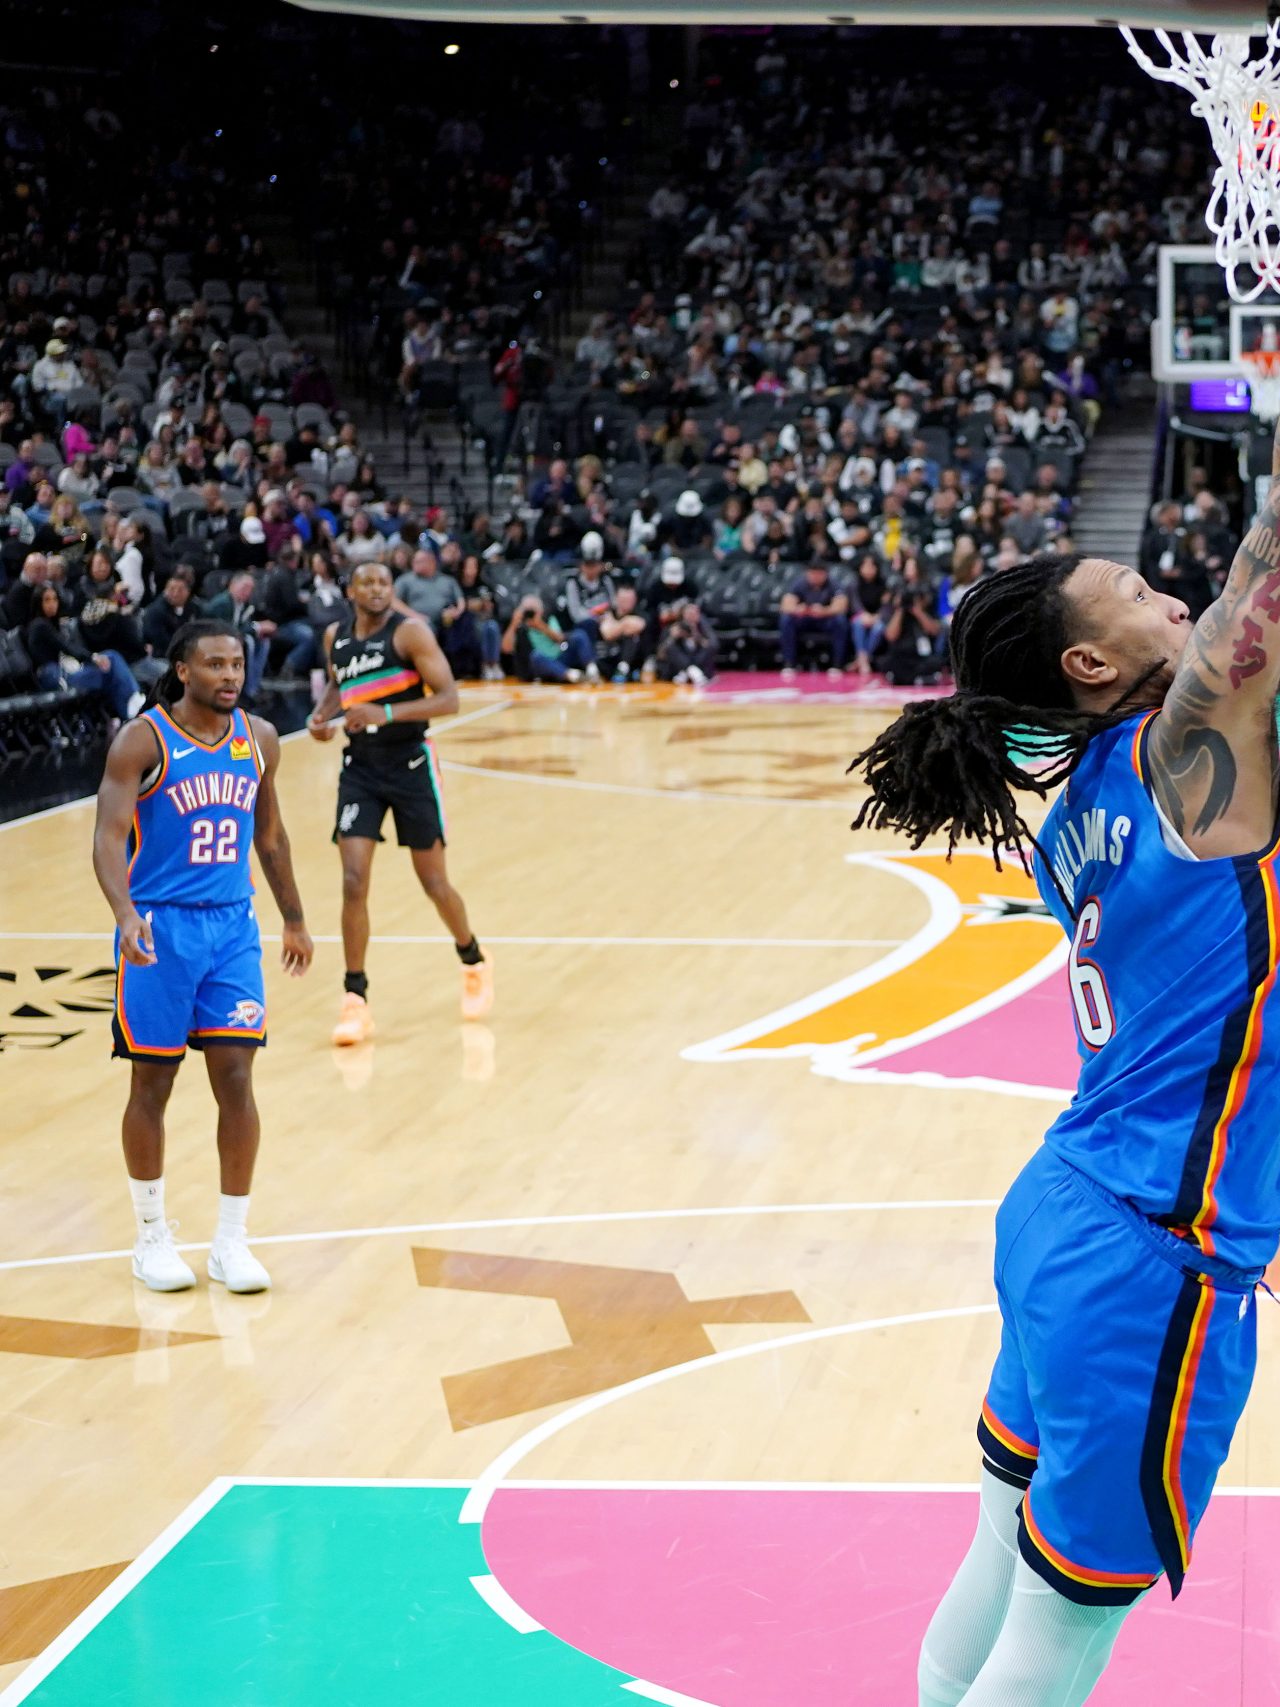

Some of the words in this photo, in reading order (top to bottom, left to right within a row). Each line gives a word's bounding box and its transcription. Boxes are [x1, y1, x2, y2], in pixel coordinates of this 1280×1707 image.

[164, 770, 259, 816] THUNDER
[190, 817, 239, 865] 22
[1068, 895, 1117, 1053] 6
